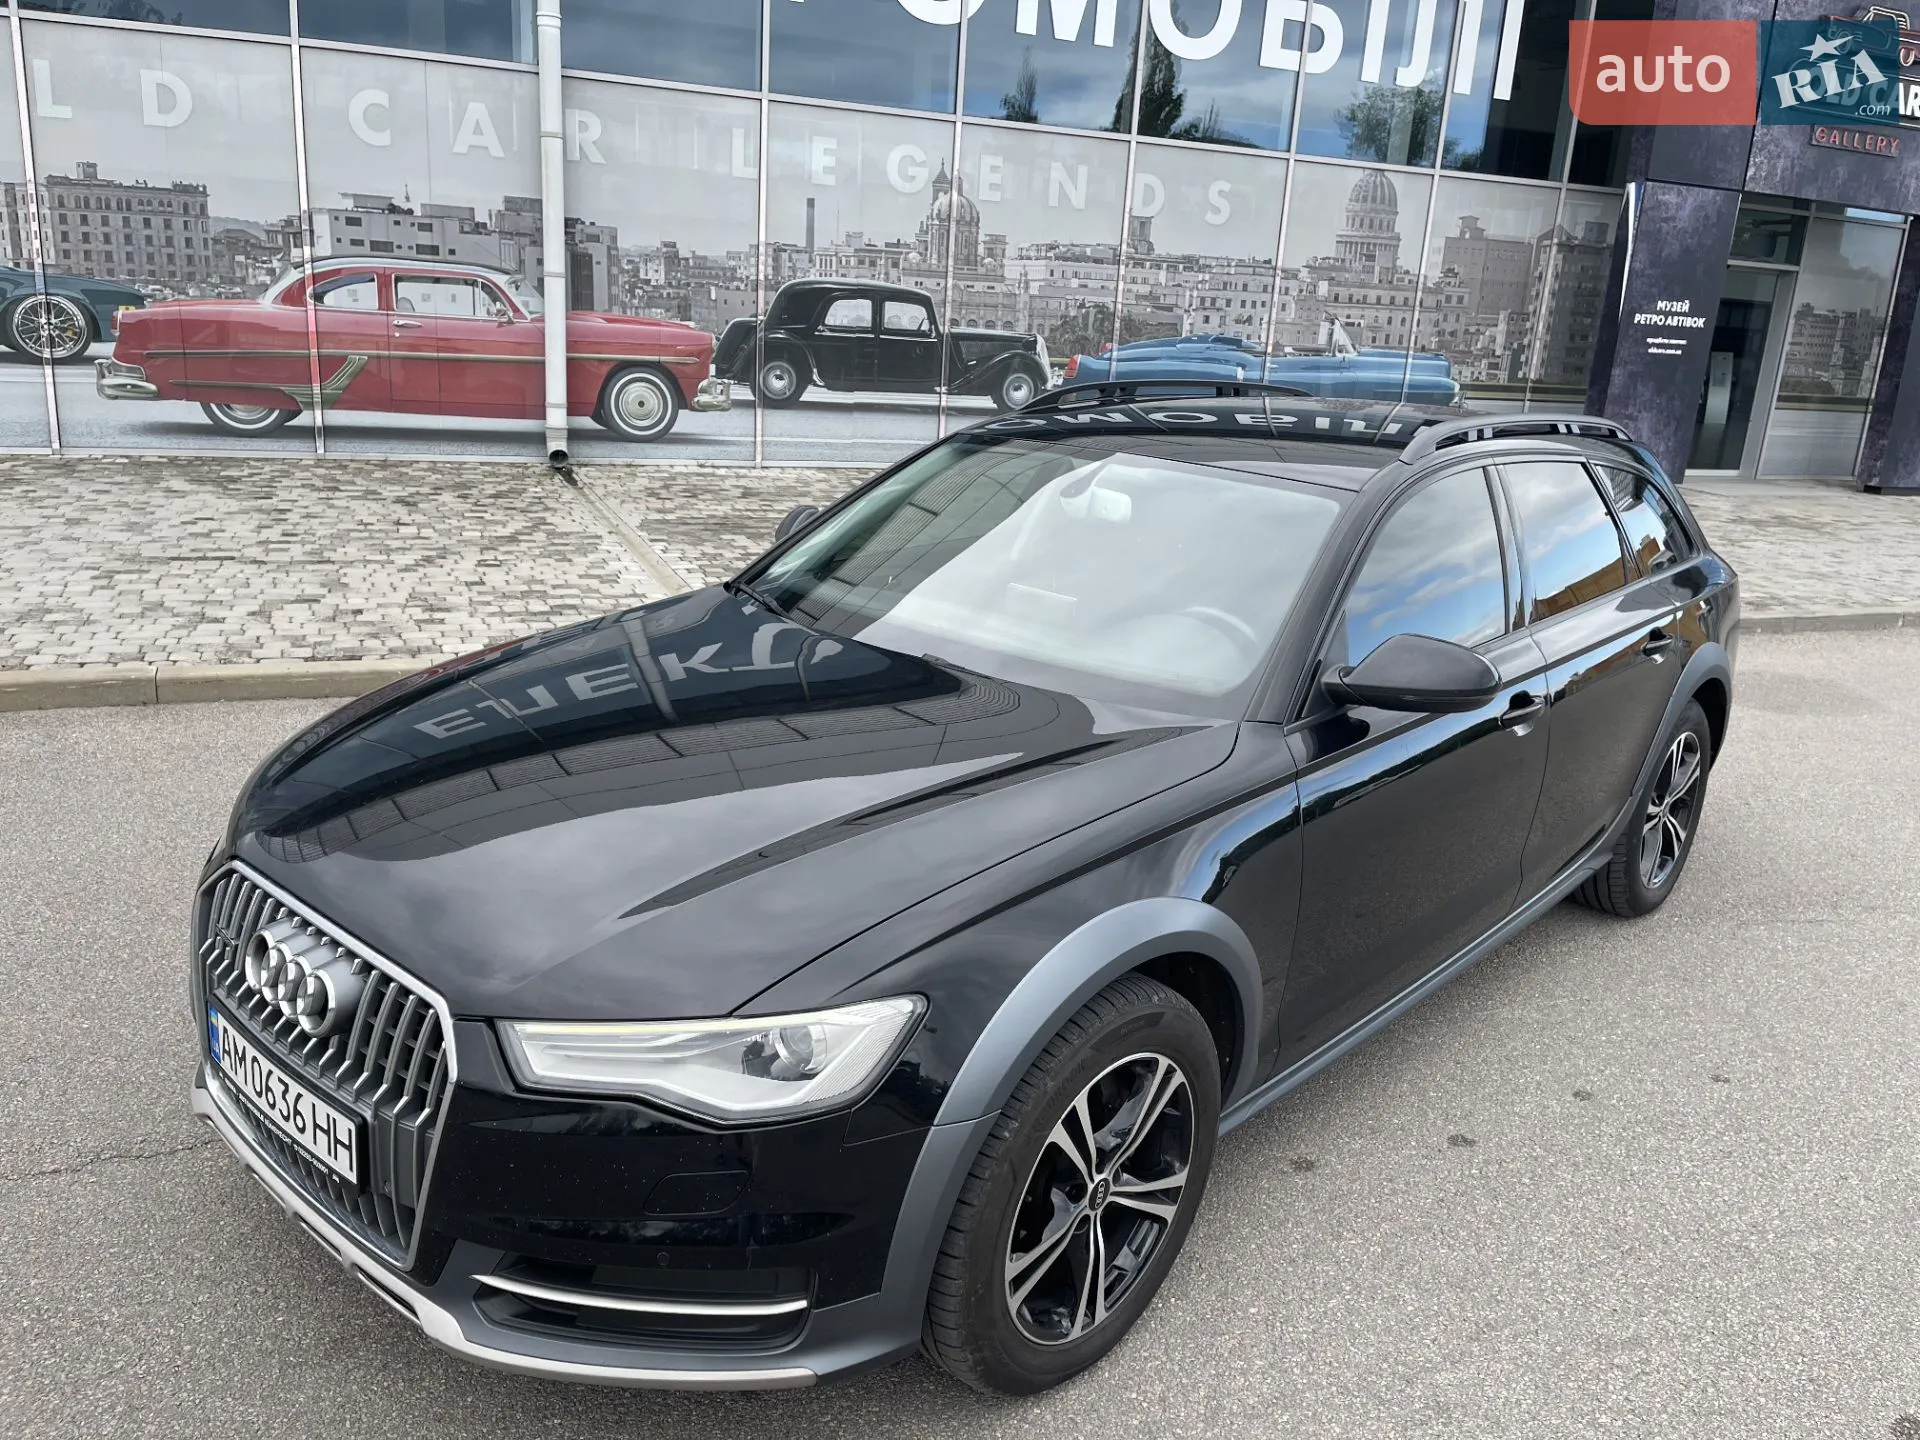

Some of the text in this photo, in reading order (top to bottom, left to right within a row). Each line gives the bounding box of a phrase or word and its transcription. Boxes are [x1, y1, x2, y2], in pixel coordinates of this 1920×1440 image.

[1815, 127, 1900, 154] GALLERY
[347, 88, 607, 165] CAR
[731, 127, 1233, 226] LEGENDS
[1633, 313, 1665, 326] РЕТРО
[1656, 299, 1690, 313] МУЗЕЙ
[221, 1025, 249, 1087] AM
[251, 1055, 307, 1135] 0636
[311, 1101, 354, 1173] HH
